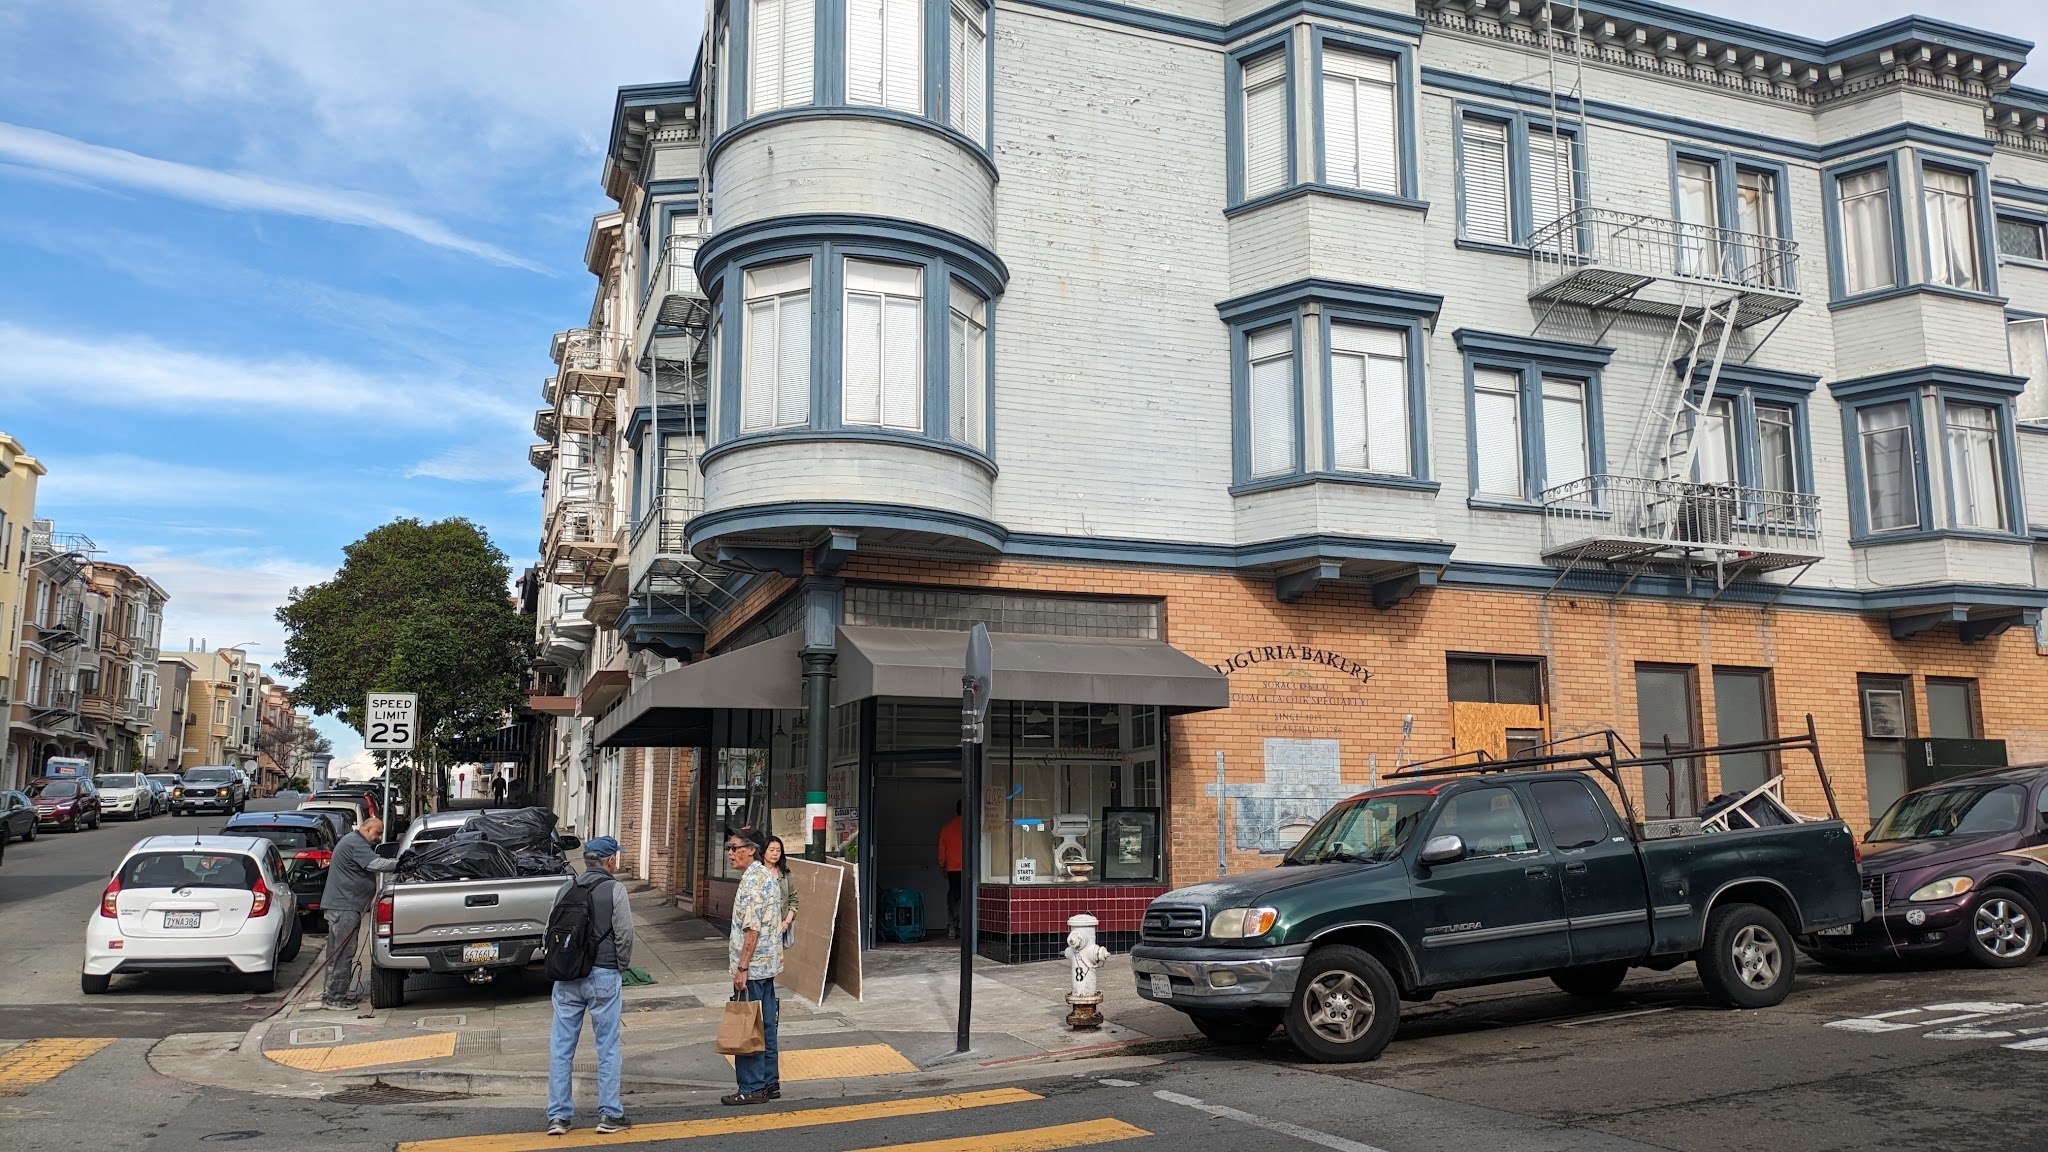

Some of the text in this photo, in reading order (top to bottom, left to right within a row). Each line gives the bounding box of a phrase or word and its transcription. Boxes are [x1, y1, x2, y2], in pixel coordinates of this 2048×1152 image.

[1214, 645, 1375, 684] LIGURIA BAKERY
[372, 699, 412, 709] SPEED
[375, 711, 407, 720] LIMIT
[1274, 713, 1302, 721] SINCE
[370, 723, 409, 743] 25
[1275, 725, 1319, 733] GARFIELD
[786, 811, 804, 822] CLO
[167, 917, 198, 926] 7YNA386
[1443, 921, 1482, 932] TUNDRA
[432, 923, 532, 936] TACOMA
[1075, 967, 1083, 981] 8
